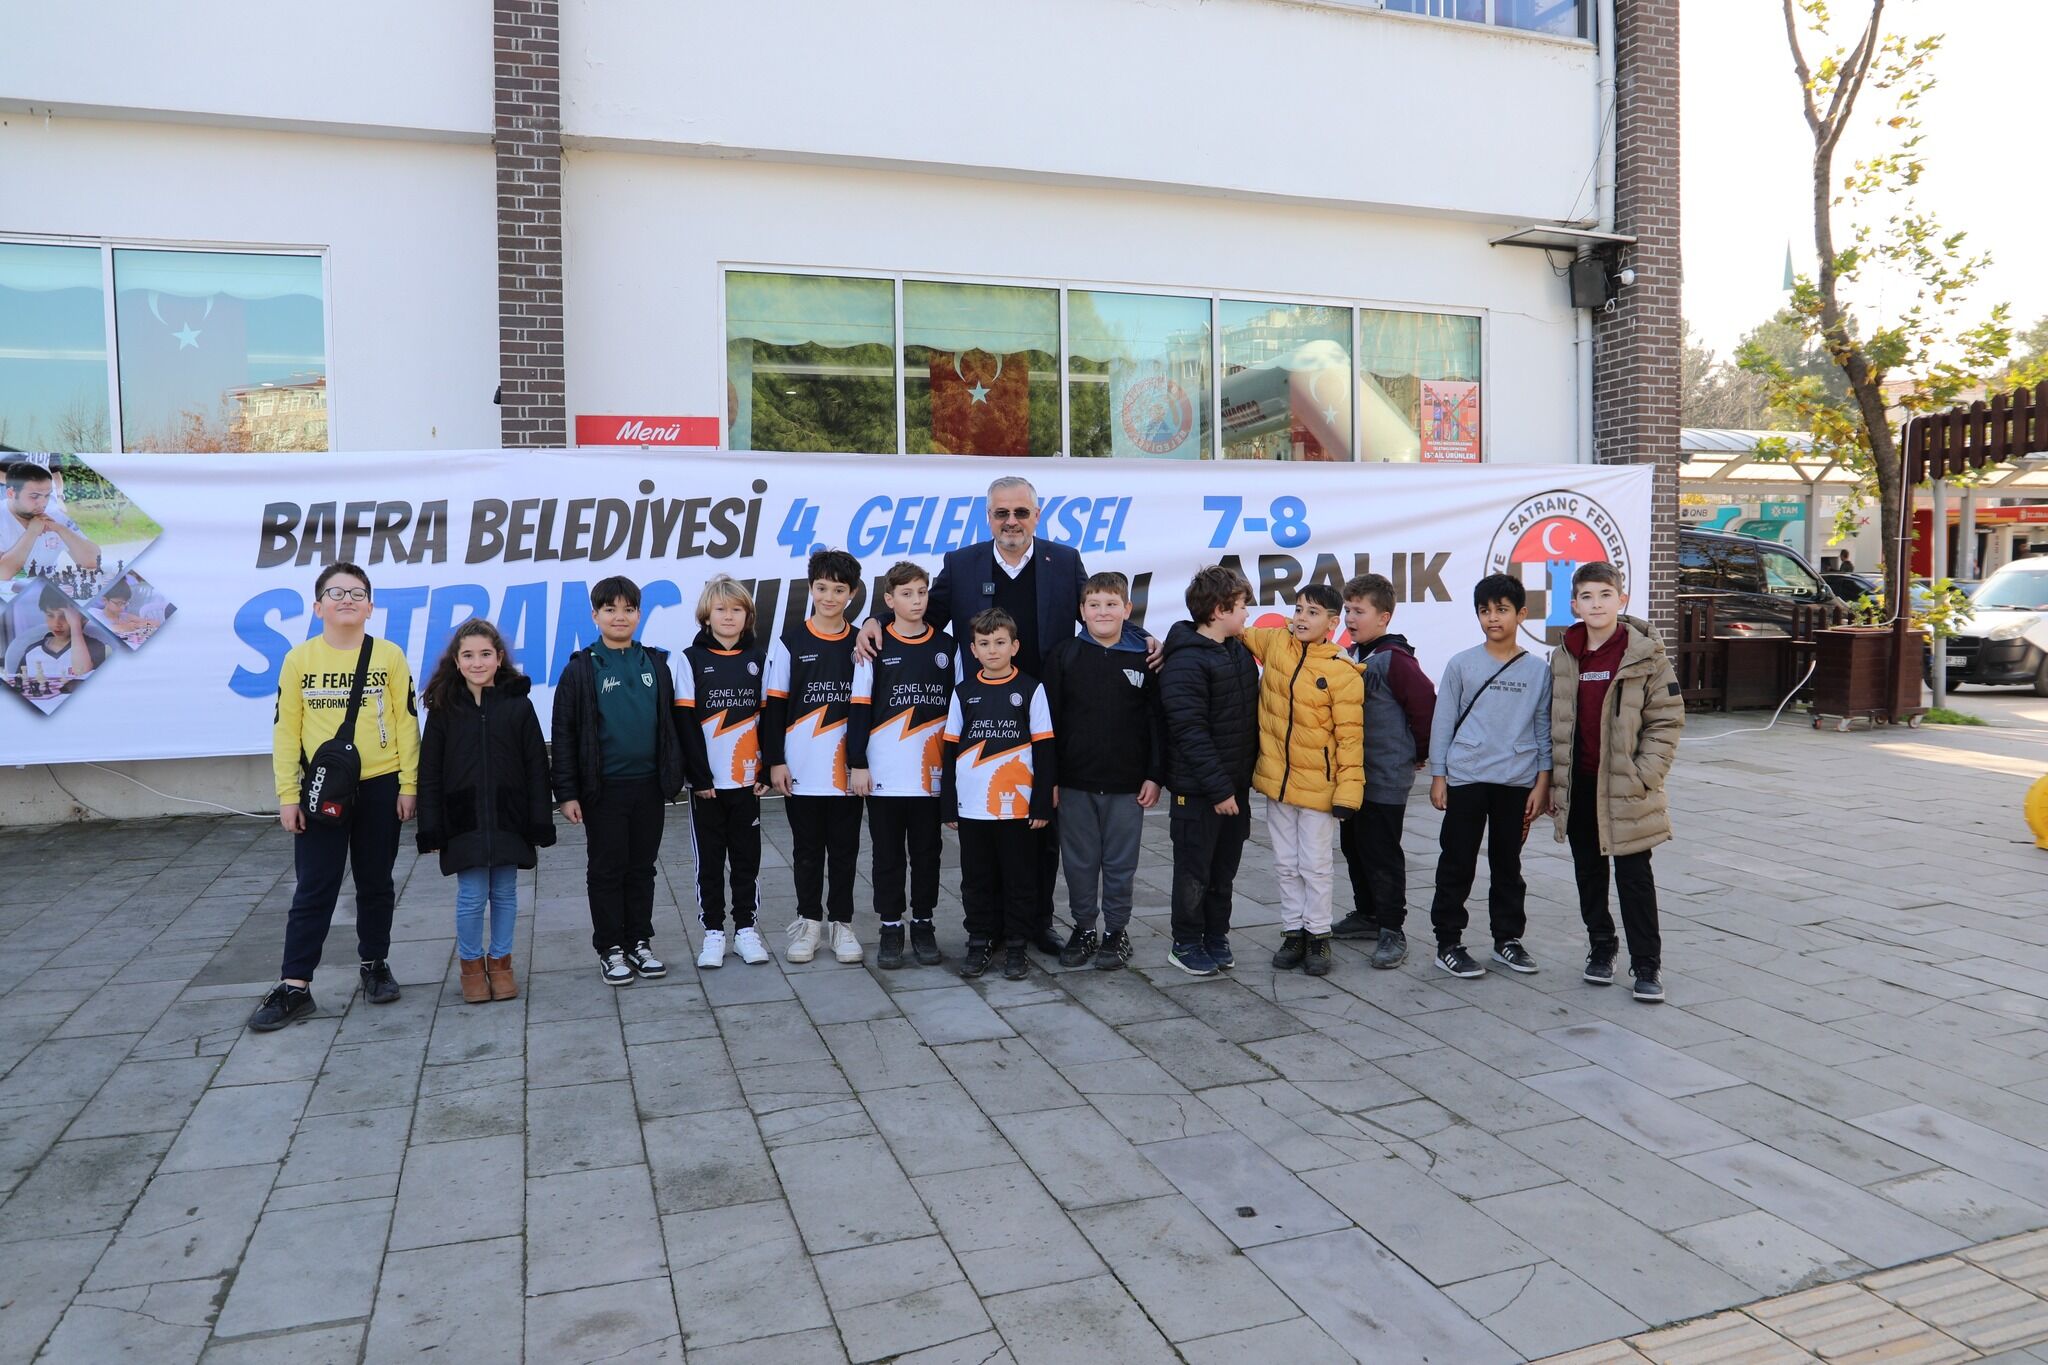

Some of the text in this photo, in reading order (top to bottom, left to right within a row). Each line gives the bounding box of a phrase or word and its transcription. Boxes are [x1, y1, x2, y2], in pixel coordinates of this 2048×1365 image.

[615, 421, 681, 441] Menü
[1508, 496, 1580, 537] SATRANÇ
[1689, 508, 1709, 517] QNB
[1780, 505, 1799, 515] TAM
[256, 499, 449, 569] BAFRA
[464, 478, 768, 564] BELEDİYESİ
[846, 495, 1134, 559] GELENKSEL
[1203, 495, 1312, 549] 7-8
[301, 671, 388, 689] BE FEARESS
[708, 688, 755, 699] ŞENEL YAPI
[807, 681, 851, 693] ŞENEL YA
[892, 683, 944, 697] ŞENEL YAPI
[308, 697, 368, 710] PERFORME
[705, 699, 725, 709] CAM
[803, 693, 825, 704] CAM
[889, 694, 947, 707] CAM BALKON
[997, 719, 1017, 729] YAPI
[985, 729, 1020, 739] BALKON
[308, 766, 327, 813] adidas
